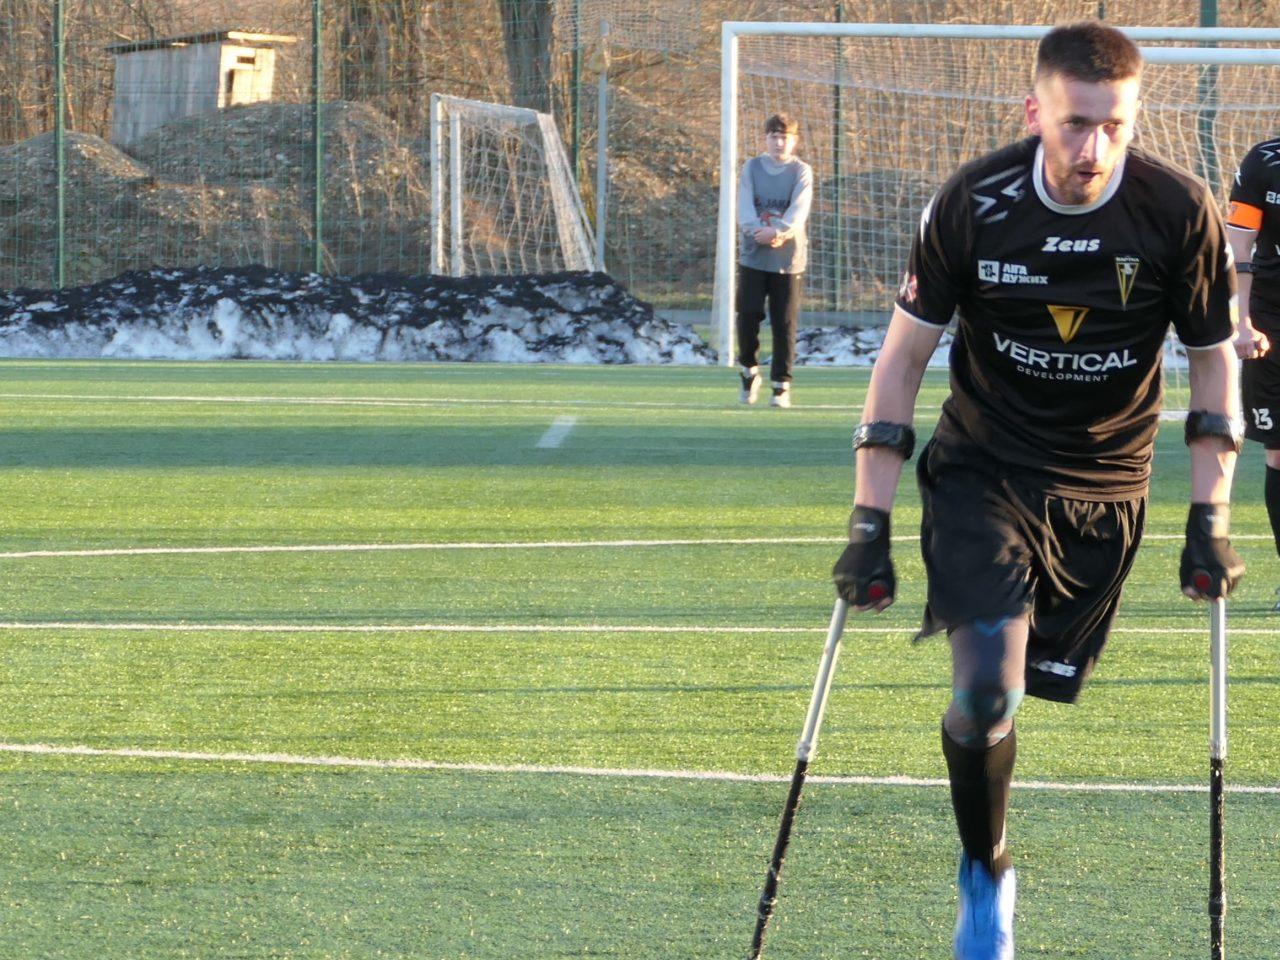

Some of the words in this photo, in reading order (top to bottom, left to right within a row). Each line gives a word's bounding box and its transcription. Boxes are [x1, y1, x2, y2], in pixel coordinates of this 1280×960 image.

[1041, 236, 1100, 252] Zeus
[992, 331, 1138, 372] VERTICAL
[1016, 364, 1109, 382] DEVELOPMENT
[1252, 407, 1273, 430] 13
